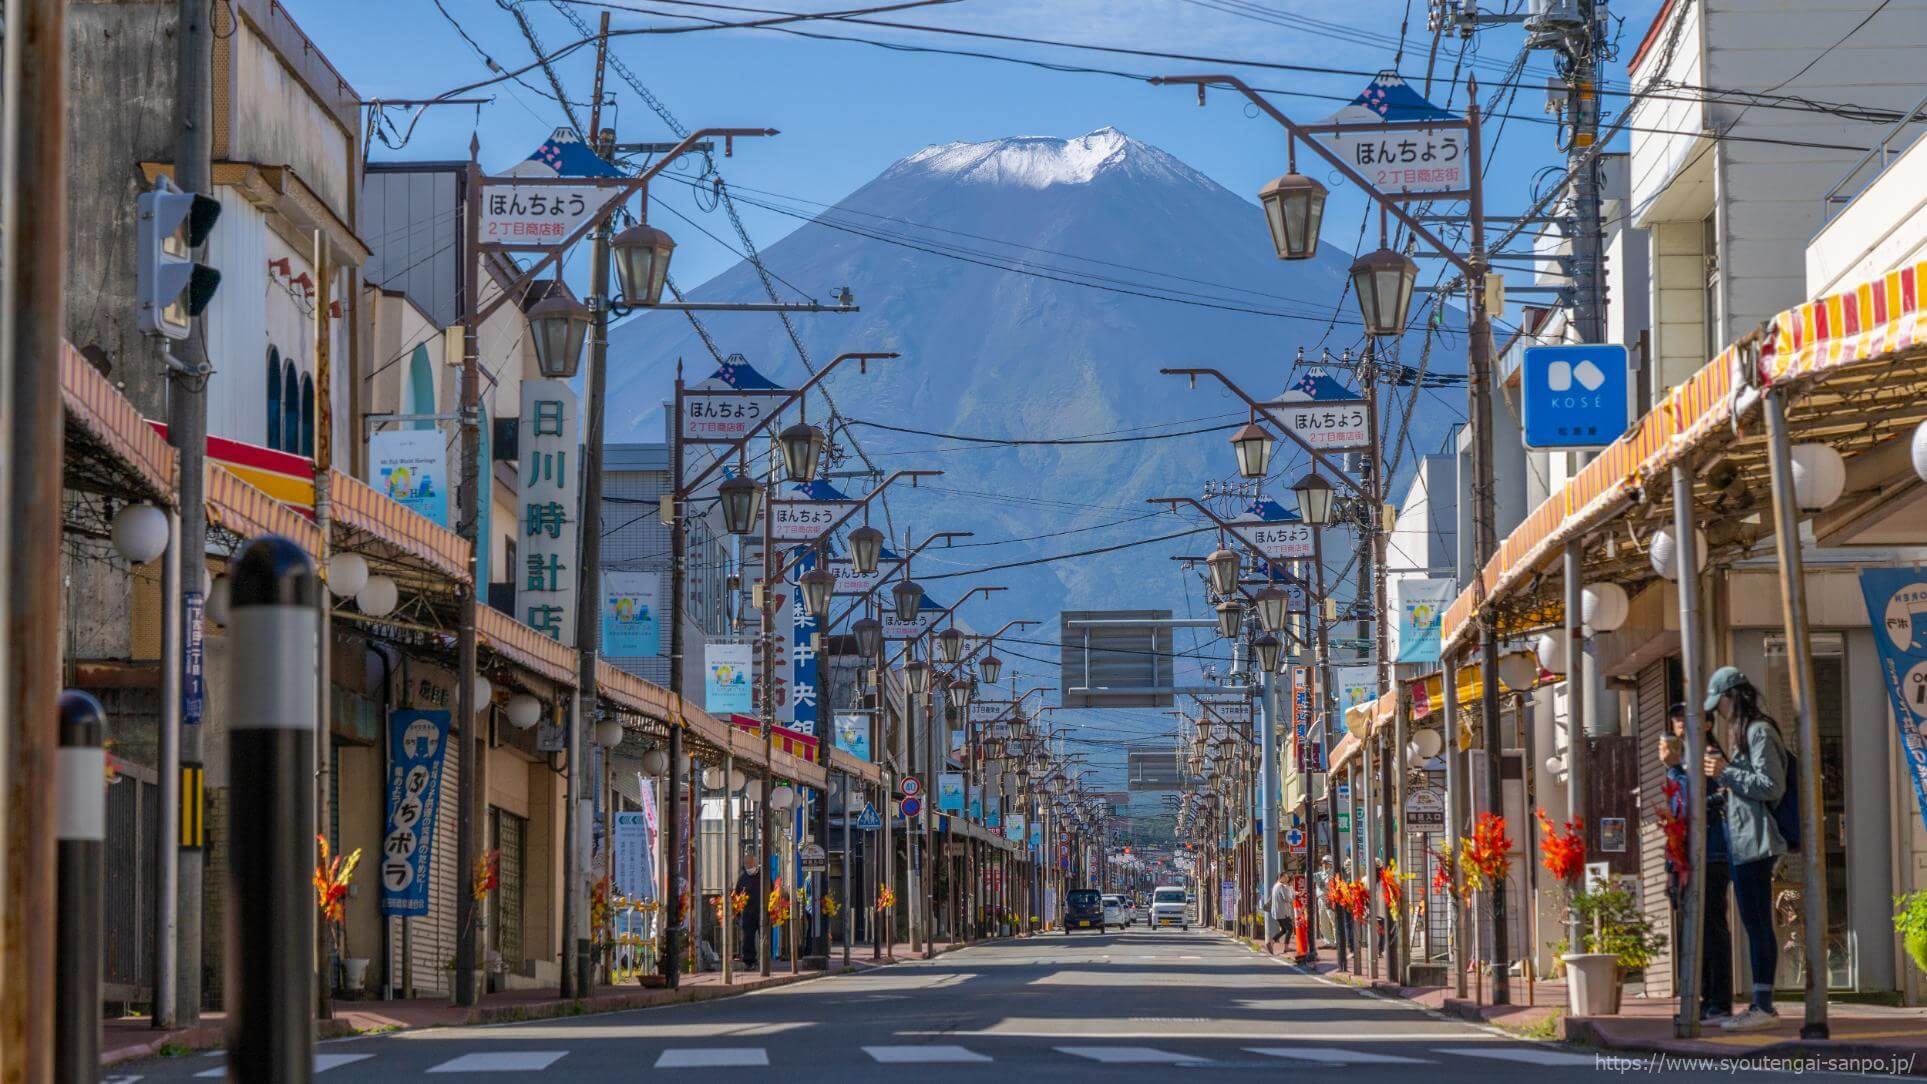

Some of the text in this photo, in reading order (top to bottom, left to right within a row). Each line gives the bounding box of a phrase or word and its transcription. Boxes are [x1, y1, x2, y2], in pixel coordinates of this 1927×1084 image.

[1356, 138, 1459, 165] ほんちょう
[1377, 167, 1459, 184] 2丁目商店街
[489, 193, 585, 216] ほんちょう
[488, 222, 565, 236] 2丁目商店街
[690, 401, 760, 419] ほんちょう
[1294, 411, 1363, 429] ほんちょう
[526, 400, 566, 641] 日川時計店
[776, 510, 833, 524] ほんちょう
[1255, 528, 1309, 543] ほんちょう
